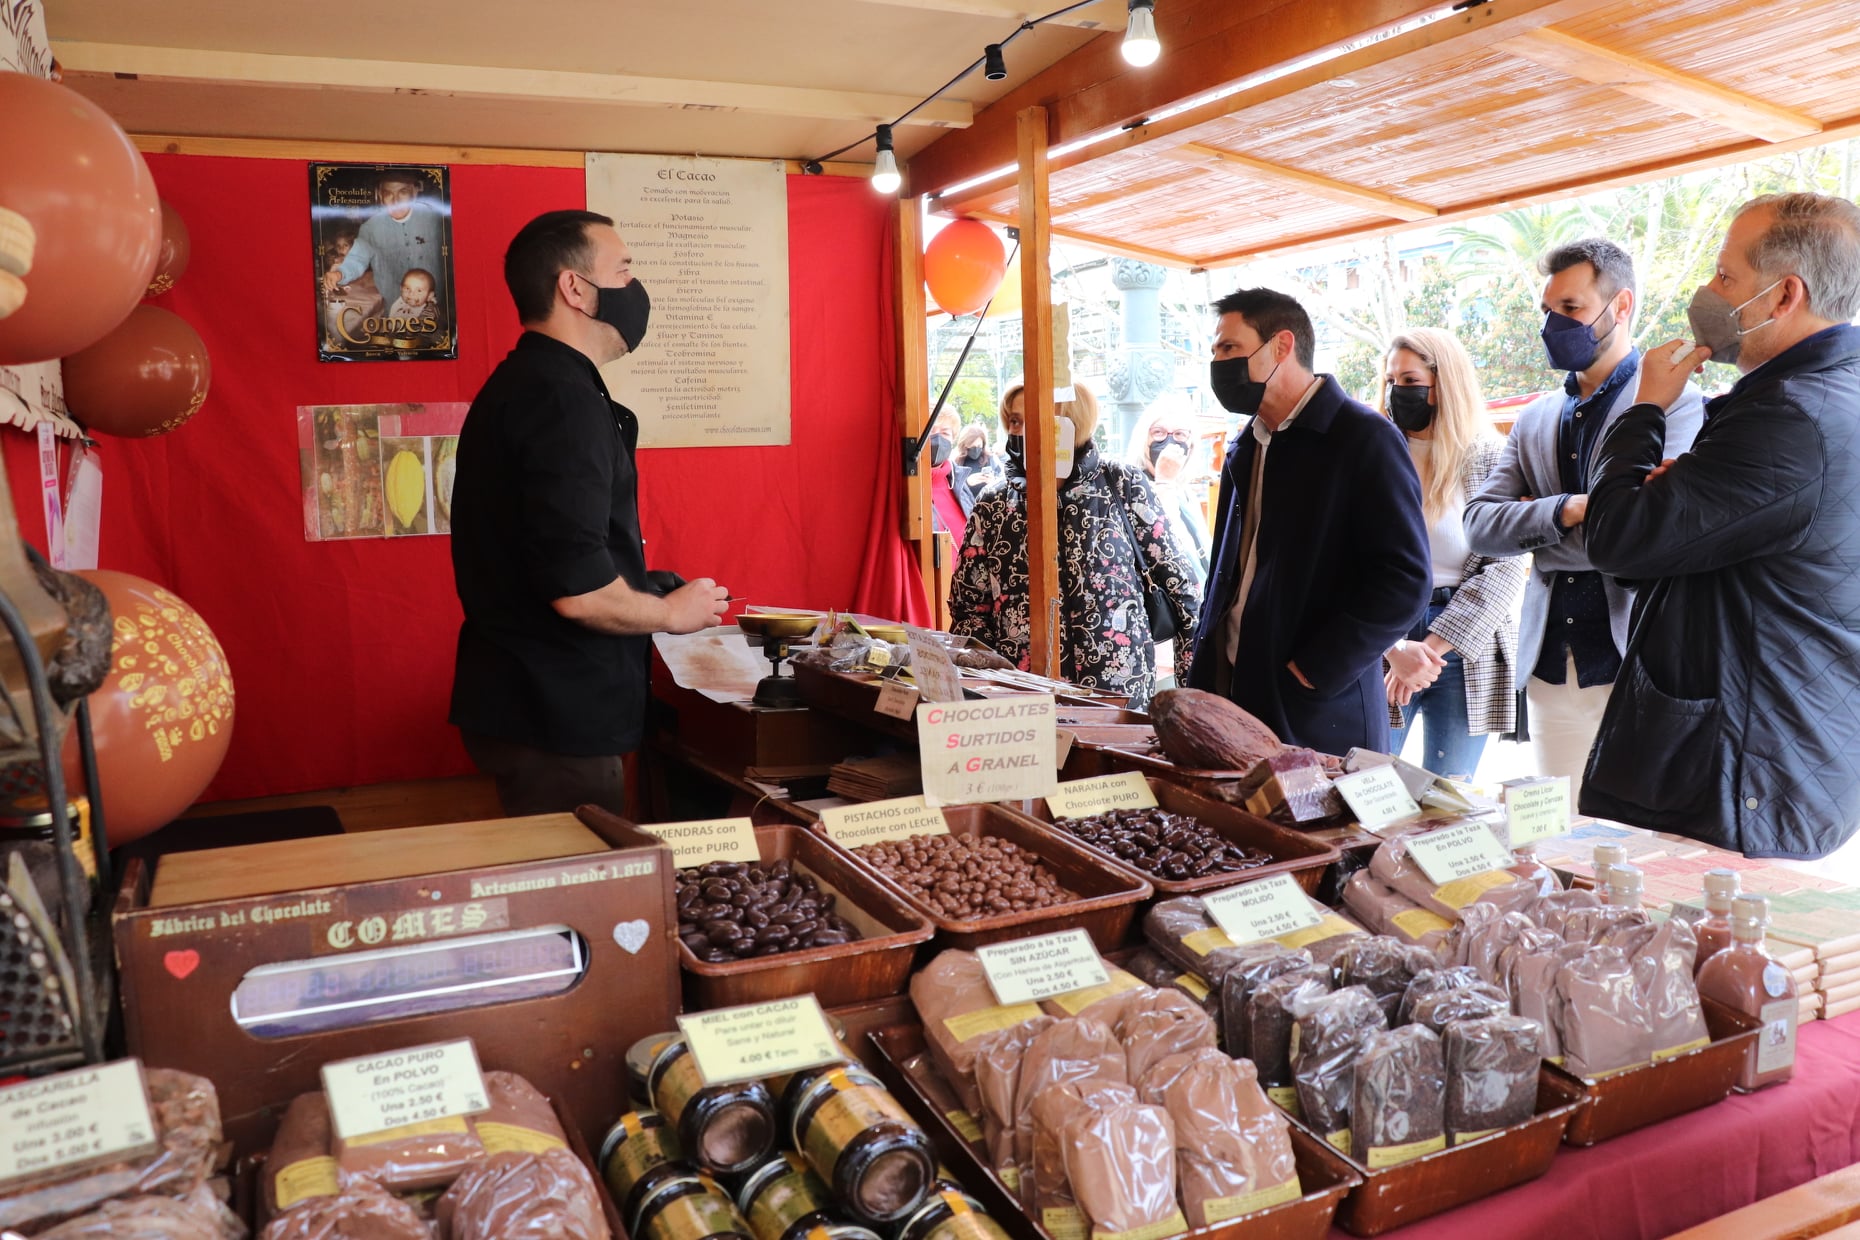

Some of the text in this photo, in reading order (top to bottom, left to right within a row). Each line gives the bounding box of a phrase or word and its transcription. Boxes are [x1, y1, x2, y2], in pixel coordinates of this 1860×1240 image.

[657, 168, 716, 182] El Cacao
[620, 221, 652, 230] fortalece
[672, 214, 704, 222] Potasio
[668, 232, 709, 240] Magnesio
[337, 306, 437, 344] Comes
[688, 332, 724, 340] Taninos
[927, 703, 1049, 725] CHOCOLATES
[946, 729, 1036, 749] SURTIDOS
[947, 754, 1039, 775] A GRANEL
[1064, 780, 1127, 794] NARANJA con
[1065, 792, 1139, 810] Chocolate PURO
[844, 806, 921, 824] PISTACHOS con
[716, 826, 736, 834] con
[835, 816, 940, 840] Chocolate con LECHE
[1412, 834, 1449, 847] Preparado
[1464, 824, 1482, 833] Taza
[706, 841, 738, 853] PURO
[1436, 837, 1473, 852] En POLVO
[1448, 861, 1463, 869] Una
[471, 861, 653, 899] Artesanos desde 1.870
[1212, 888, 1253, 904] Preparado
[1260, 883, 1268, 891] la
[1269, 879, 1288, 889] Taza
[1242, 893, 1274, 908] MOLIDO
[150, 900, 331, 937] Fábrica del Chocolate
[327, 903, 488, 949] COMES
[1250, 919, 1267, 928] Una
[1258, 928, 1275, 937] Dos
[987, 943, 1036, 958] Preparado
[1045, 937, 1054, 947] la
[1056, 934, 1078, 944] Taza
[1009, 947, 1070, 965] SIN AZÚCAR
[1026, 977, 1044, 986] Una
[1047, 971, 1065, 981] 2.50
[1032, 987, 1051, 996] Dos
[1052, 982, 1071, 992] 4.50
[701, 1001, 799, 1025] MIEL con CACAO
[715, 1026, 737, 1036] Para
[740, 1021, 764, 1032] untar
[762, 1028, 795, 1041] Natural
[356, 1049, 445, 1074] CACAO PURO
[740, 1053, 762, 1064] 4.00
[765, 1052, 772, 1060] €
[373, 1064, 439, 1086] En POLVO
[11, 1094, 88, 1120] de Cacao
[381, 1092, 444, 1113] Una 2.50 €
[384, 1105, 448, 1127] Dos 4.50 €
